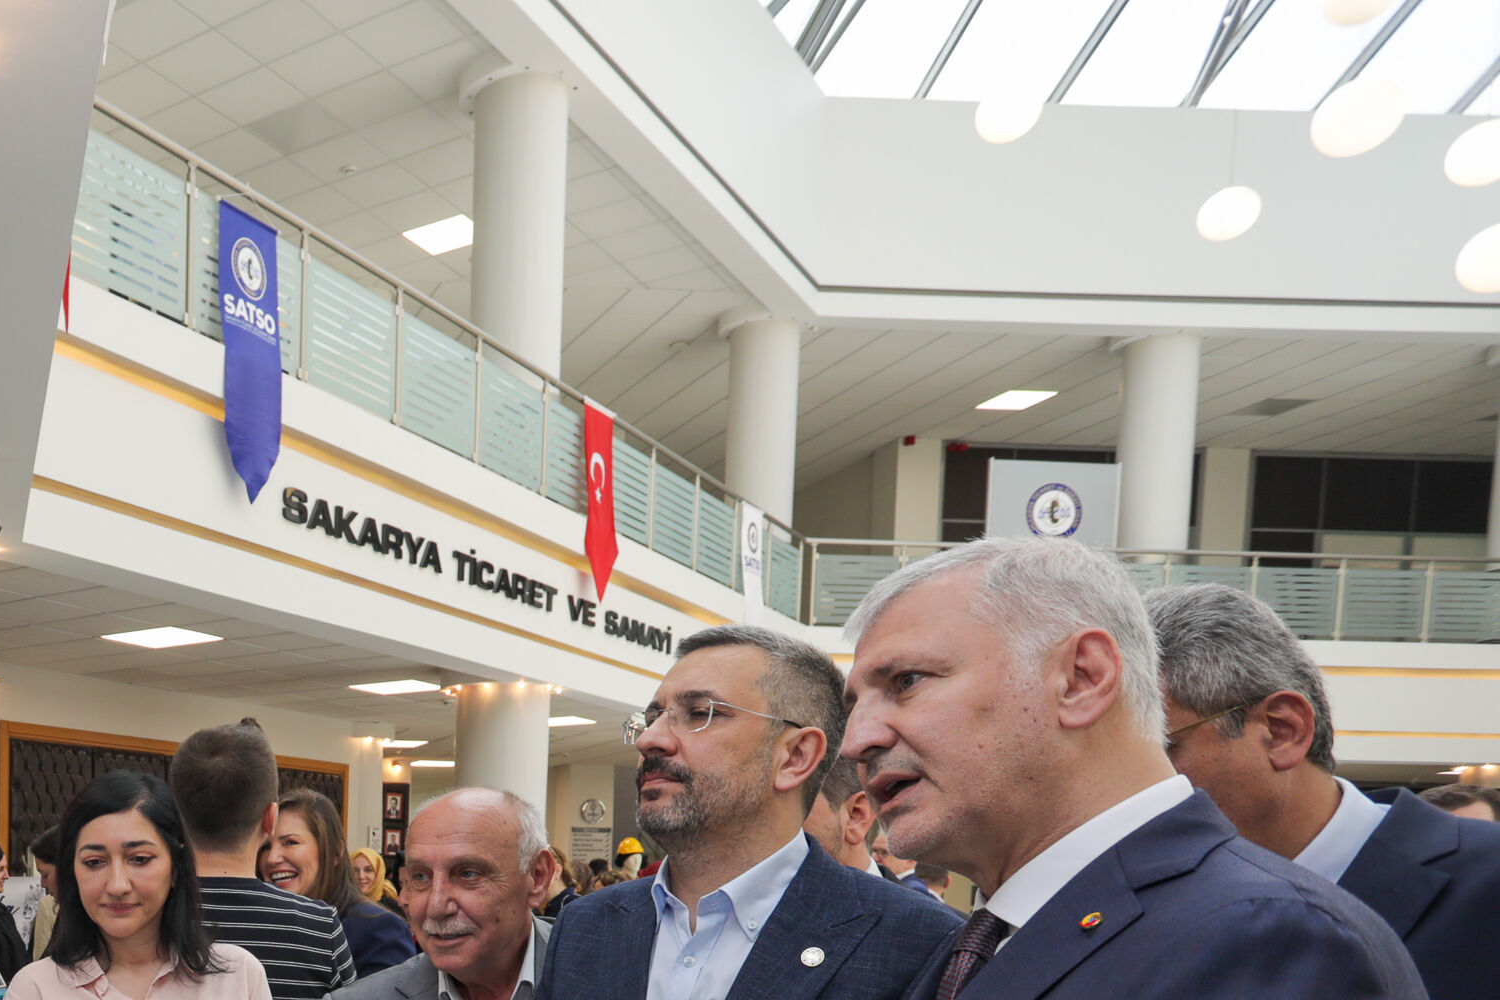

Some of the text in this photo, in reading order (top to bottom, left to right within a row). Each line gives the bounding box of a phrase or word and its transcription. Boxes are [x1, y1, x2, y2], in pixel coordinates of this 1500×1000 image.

[223, 293, 276, 335] SATSO
[282, 486, 672, 655] SAKARYA TİCARET VE SANAYİ
